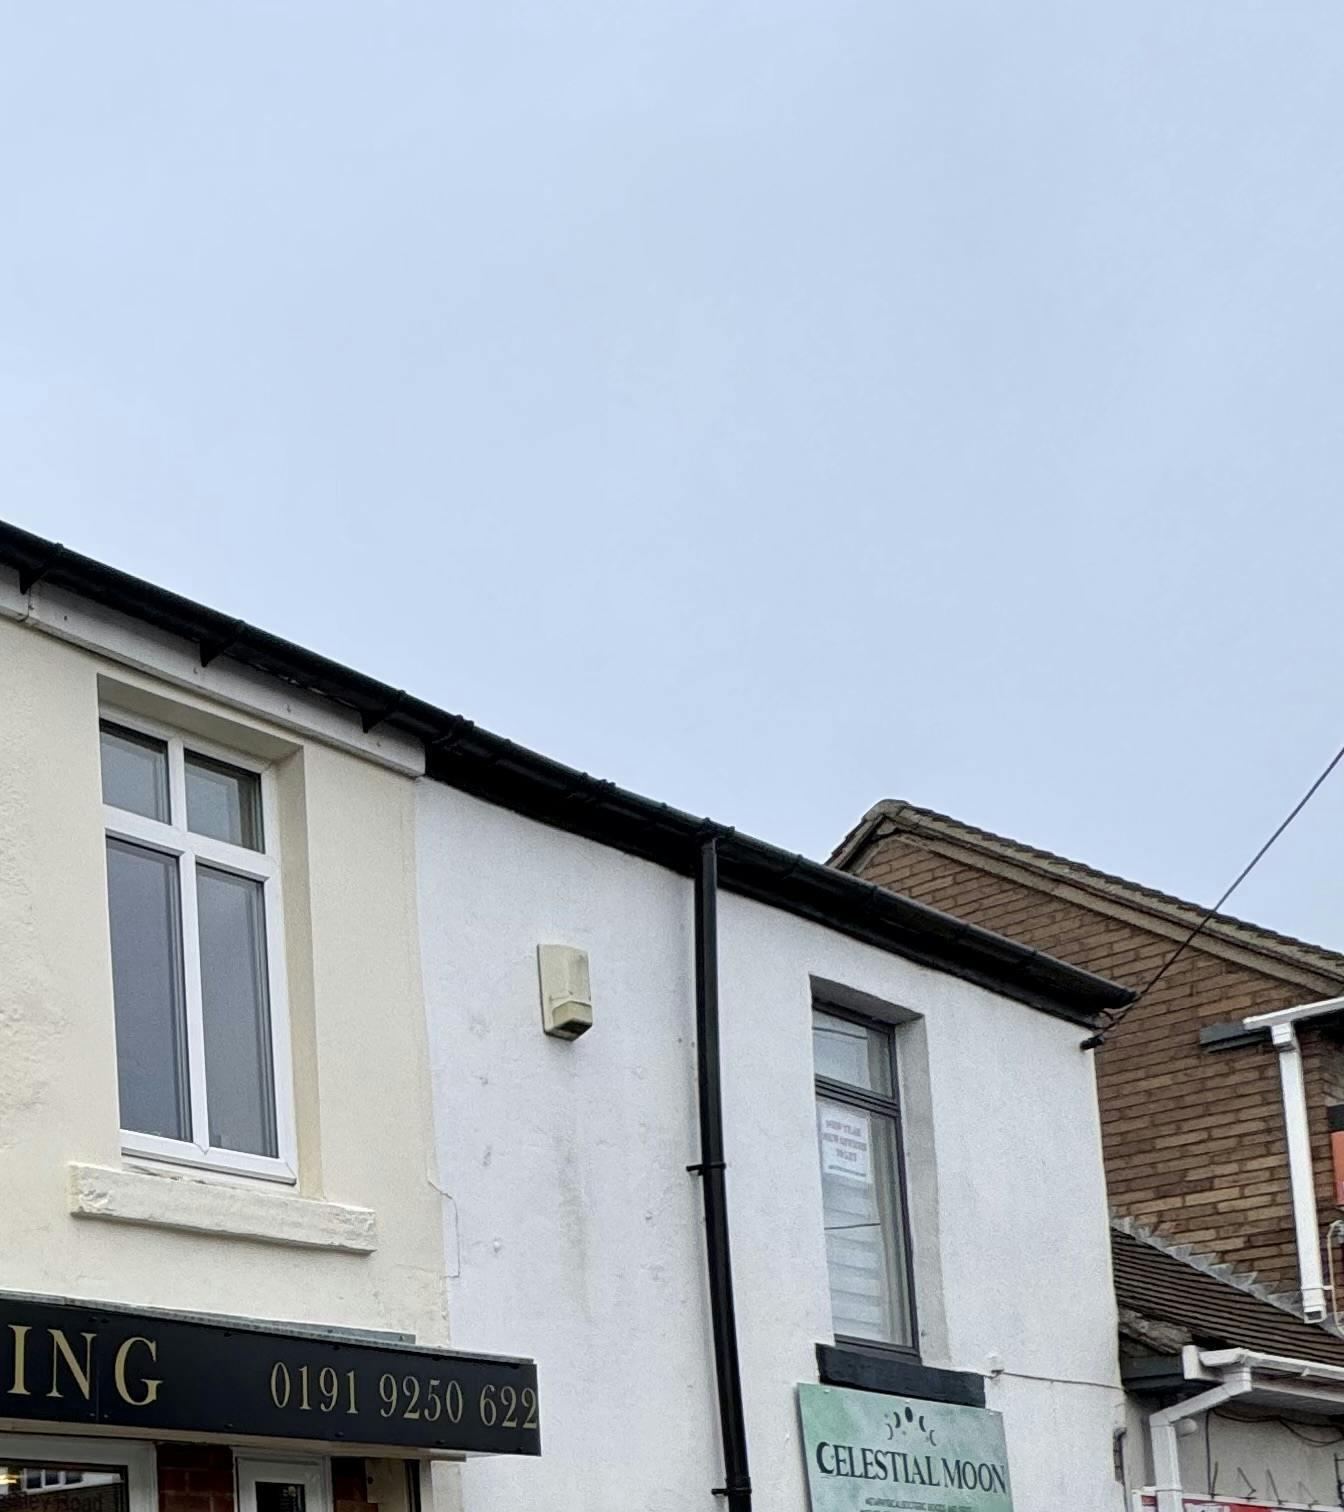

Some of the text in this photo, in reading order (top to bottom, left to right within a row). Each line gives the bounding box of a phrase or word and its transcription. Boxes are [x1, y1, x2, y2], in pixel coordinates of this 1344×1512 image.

[270, 1361, 538, 1430] 0191 9250 622
[816, 1441, 1007, 1494] CELESTIAL MOON
